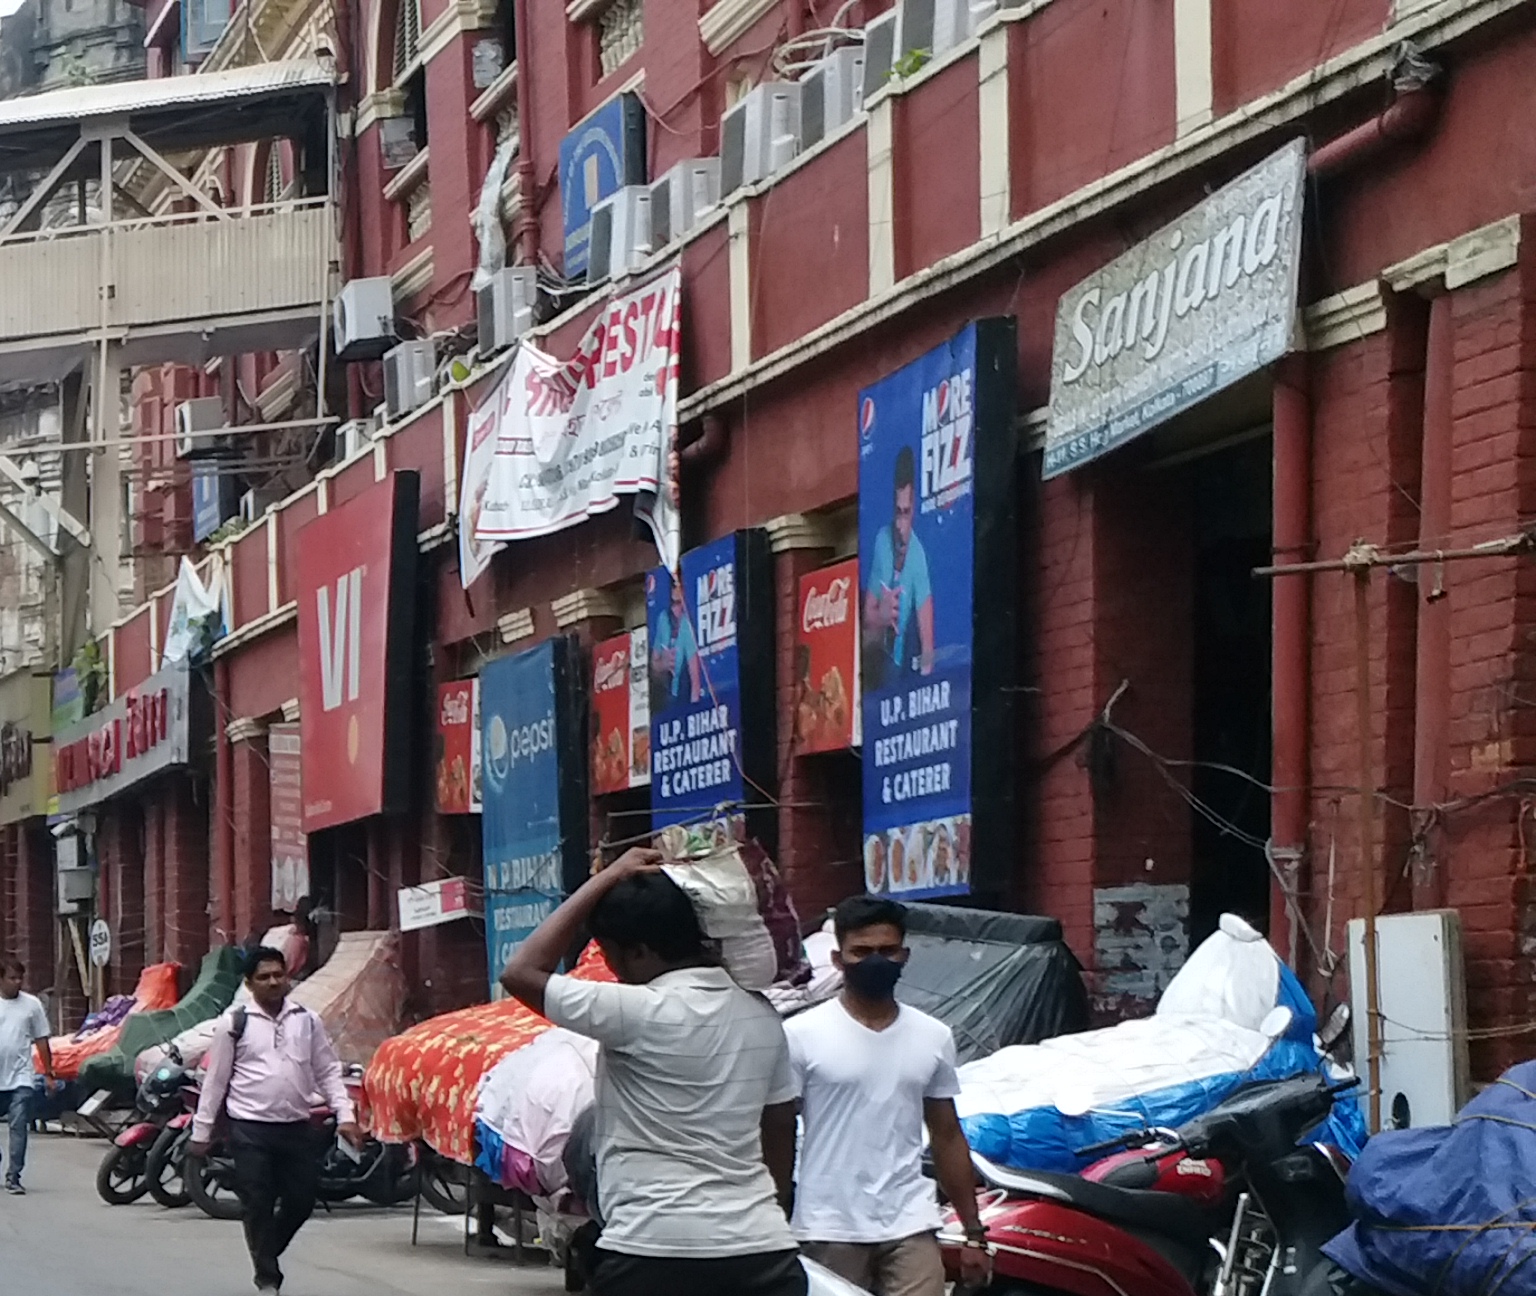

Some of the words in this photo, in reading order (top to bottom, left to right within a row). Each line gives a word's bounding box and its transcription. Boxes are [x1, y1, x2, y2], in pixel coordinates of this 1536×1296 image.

[1062, 191, 1284, 383] Sanjana
[922, 368, 971, 436] MORE
[920, 413, 972, 498] FIZZ
[687, 703, 729, 739] BIHAR
[880, 696, 906, 727] U.P.
[909, 680, 951, 719] BIHAR
[510, 709, 555, 768] pepsi
[653, 729, 738, 774] RESTAURANT
[874, 719, 960, 768] RESTAURANT
[660, 774, 672, 799] &
[672, 758, 732, 796] CATERER
[881, 776, 893, 805] &
[894, 762, 951, 802] CATERER
[494, 901, 551, 931] RESTAURAN
